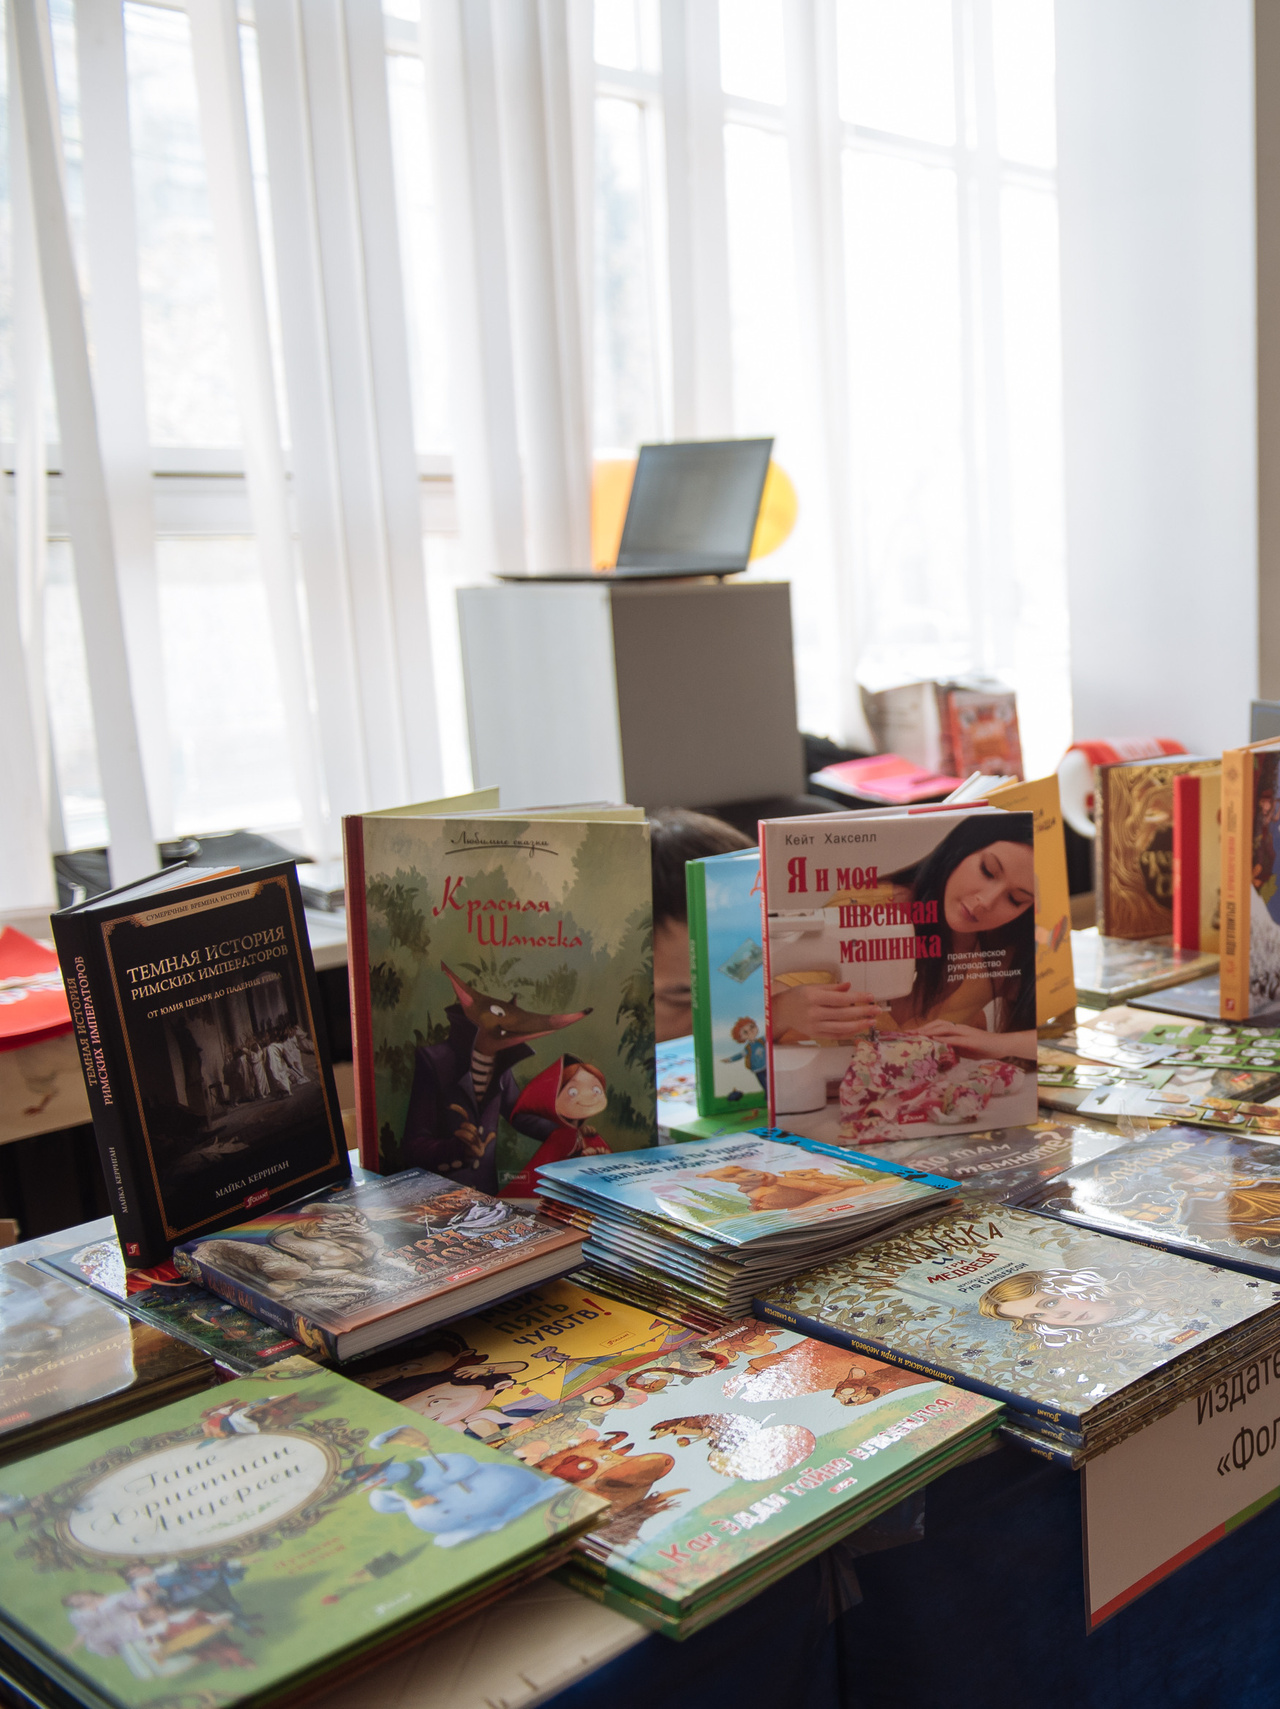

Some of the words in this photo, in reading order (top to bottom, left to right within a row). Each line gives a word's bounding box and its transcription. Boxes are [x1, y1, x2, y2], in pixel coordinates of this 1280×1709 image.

[451, 831, 509, 846] Любимые
[513, 838, 549, 858] сказки
[785, 833, 815, 846] Кейт
[824, 832, 877, 844] Хакселл
[787, 857, 808, 893] Я
[815, 868, 829, 892] и
[836, 866, 878, 891] моя
[146, 905, 189, 922] СУМЕРЕЧНЫЕ
[190, 897, 219, 910] ВРЕМЕНА
[220, 889, 250, 902] ИСТОРИИ
[433, 875, 550, 933] Красная
[838, 897, 939, 929] швейная
[477, 914, 583, 948] Шапочка
[839, 934, 942, 964] машинка
[126, 949, 201, 984] ТЕМНАЯ
[205, 925, 286, 962] ИСТОРИЯ
[131, 971, 196, 1001] РИМСКИХ
[198, 944, 289, 981] ИМПЕРАТОРОВ
[947, 949, 1006, 961] практическое
[947, 960, 1002, 973] руководство
[947, 973, 964, 982] для
[966, 969, 1021, 980] начинающих
[66, 977, 87, 1035] ИСТОРИЯ
[74, 956, 101, 1045] ИМПЕРАТОРОВ
[147, 1009, 159, 1019] ОТ
[160, 1002, 184, 1016] ЮЛИЯ
[185, 993, 213, 1008] ЦЕЗАРЯ
[214, 989, 225, 999] ДО
[226, 977, 261, 995] ПАДЕНИЯ
[80, 1037, 98, 1087] ТЕМНАЯ
[94, 1047, 114, 1106] РИМСКИХ
[108, 1146, 123, 1185] КЕРРИГАН
[215, 1179, 246, 1199] МАЙКЛ
[248, 1160, 290, 1185] КЕРРИГАН
[906, 1155, 948, 1171] то
[927, 1252, 1000, 1284] МЕДВЕДЯ
[493, 1302, 570, 1335] ПЯТЬ
[513, 1297, 612, 1345] ЧУВСТВ!
[90, 1446, 293, 1531] Христиан
[123, 1454, 218, 1496] Ганс
[132, 1463, 304, 1544] Андерсен
[657, 1531, 721, 1566] Как
